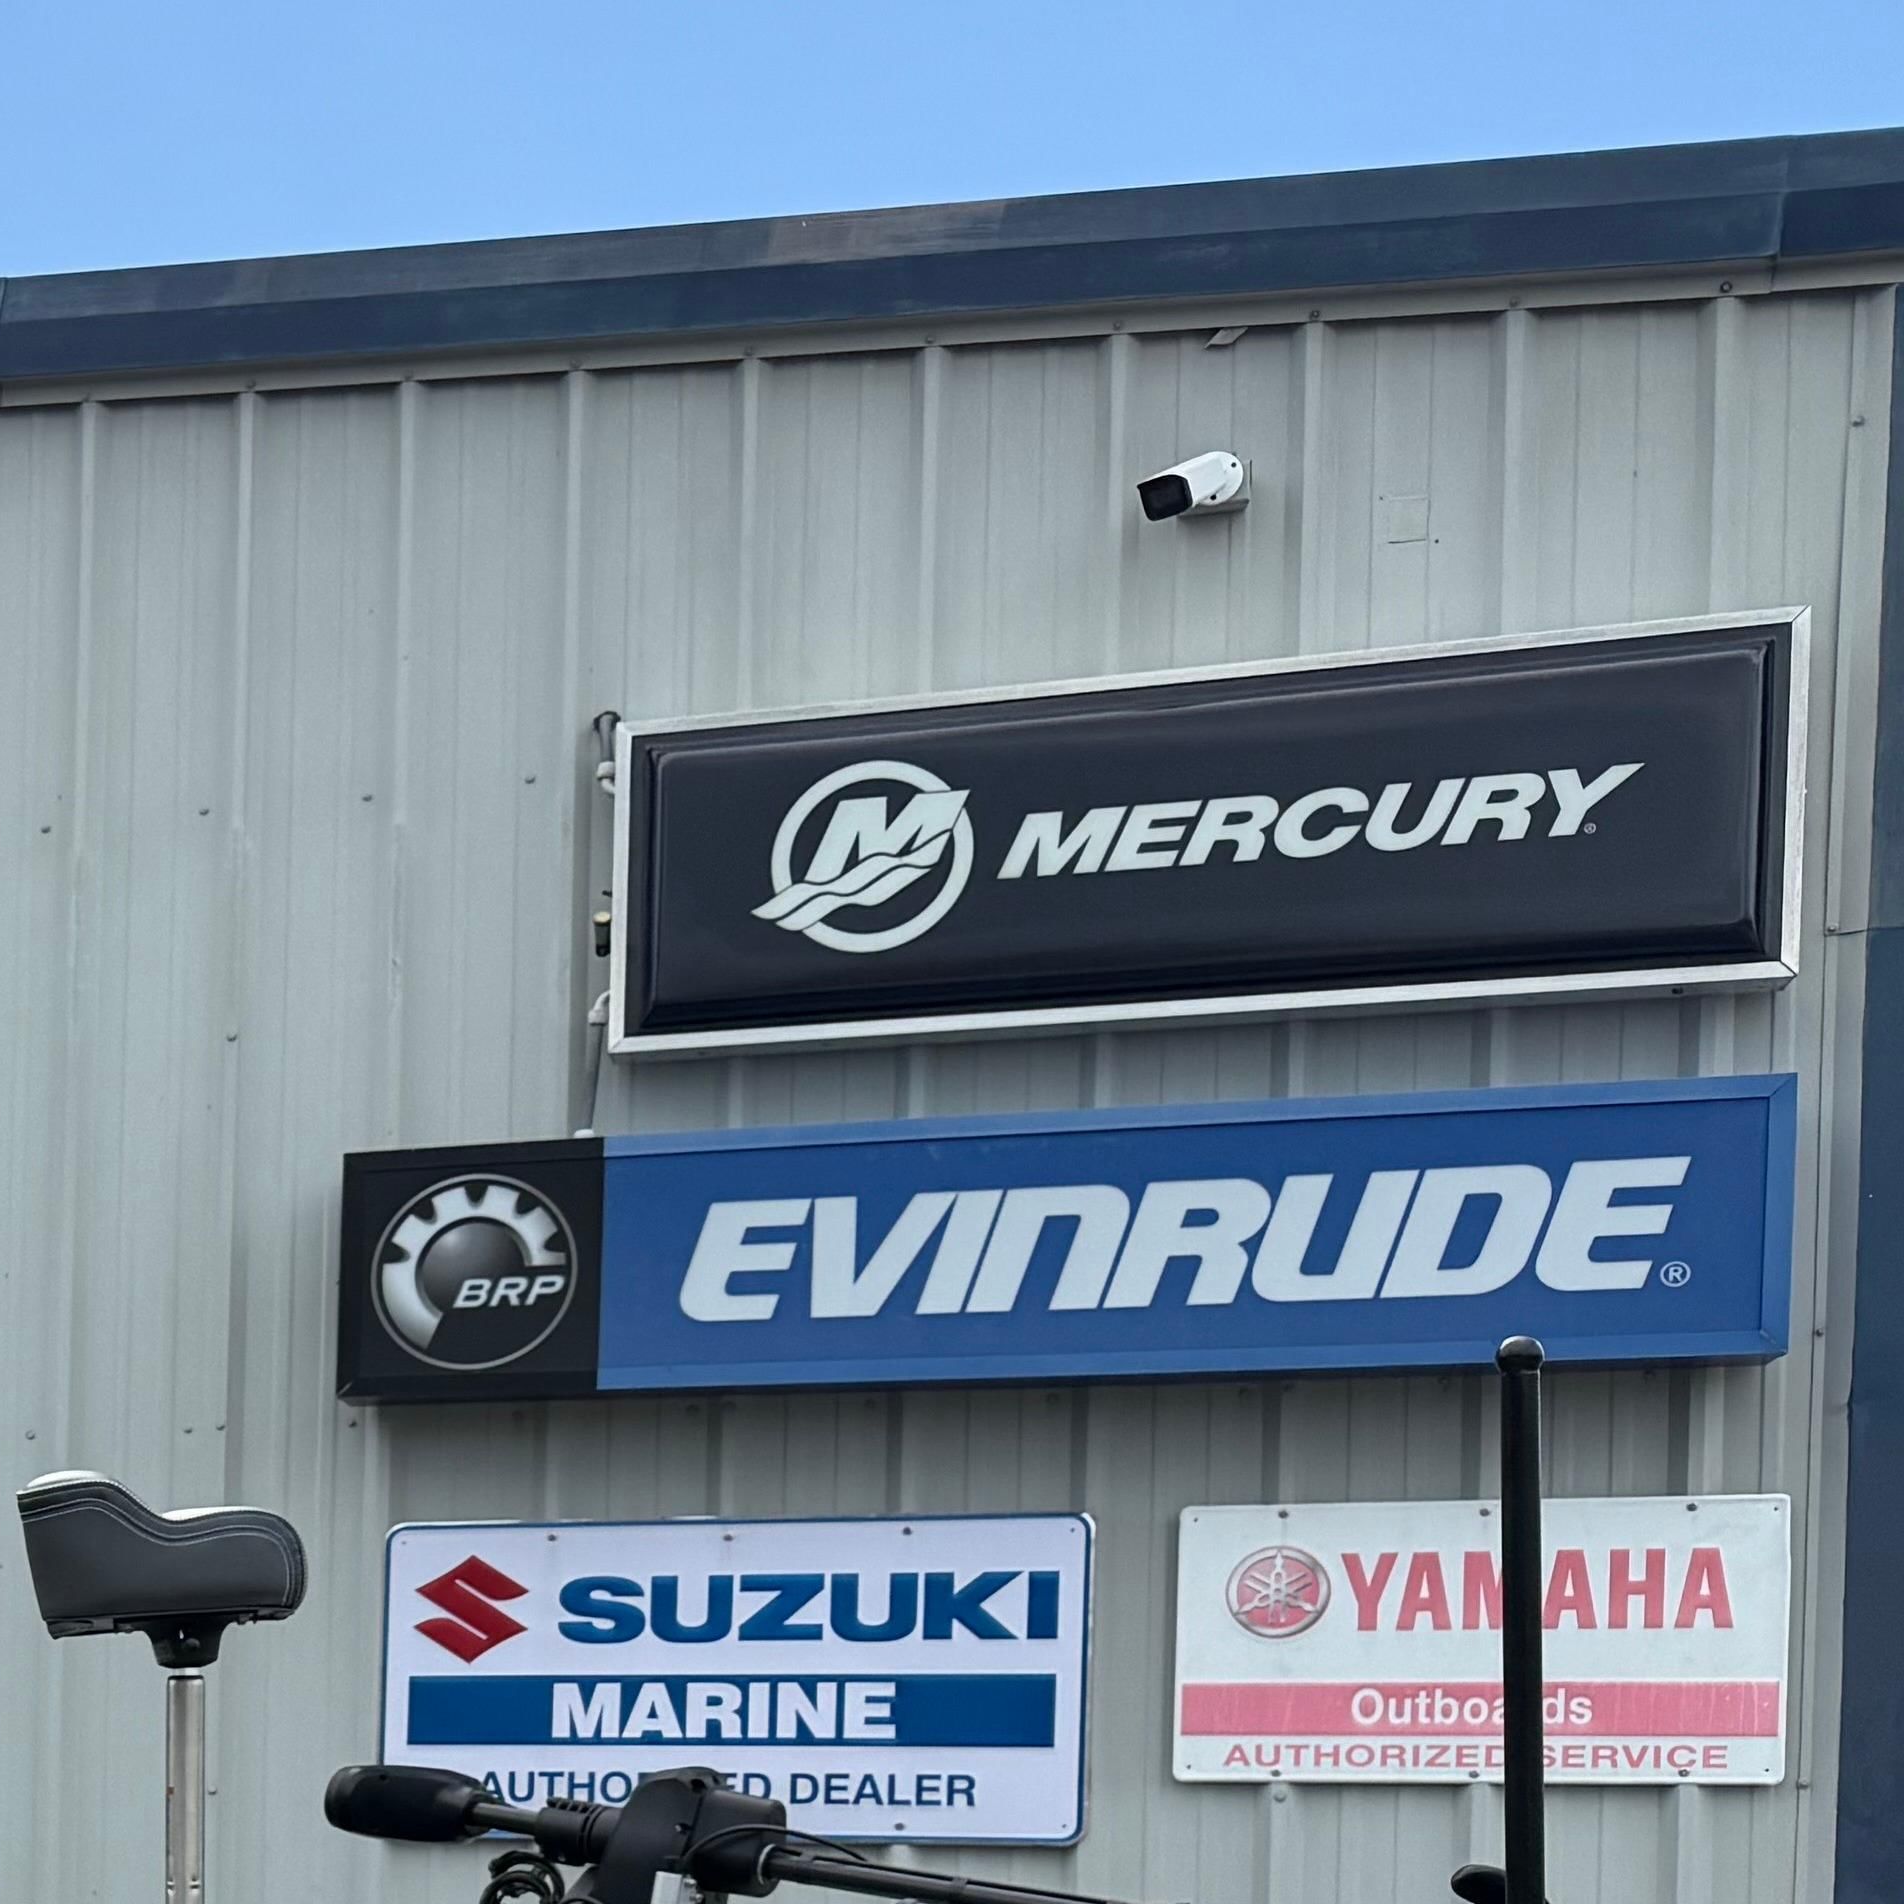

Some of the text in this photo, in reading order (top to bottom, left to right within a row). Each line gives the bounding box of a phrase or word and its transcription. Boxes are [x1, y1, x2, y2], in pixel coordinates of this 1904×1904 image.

[996, 760, 1646, 881] MERCURY
[678, 1155, 1692, 1324] EVINRUDE
[451, 1274, 567, 1310] BRP
[557, 1569, 1061, 1645] SUZUKI
[551, 1681, 897, 1740] MARINE
[1351, 1686, 1593, 1727] Outbods
[482, 1770, 977, 1808] AUTHOD DEALER
